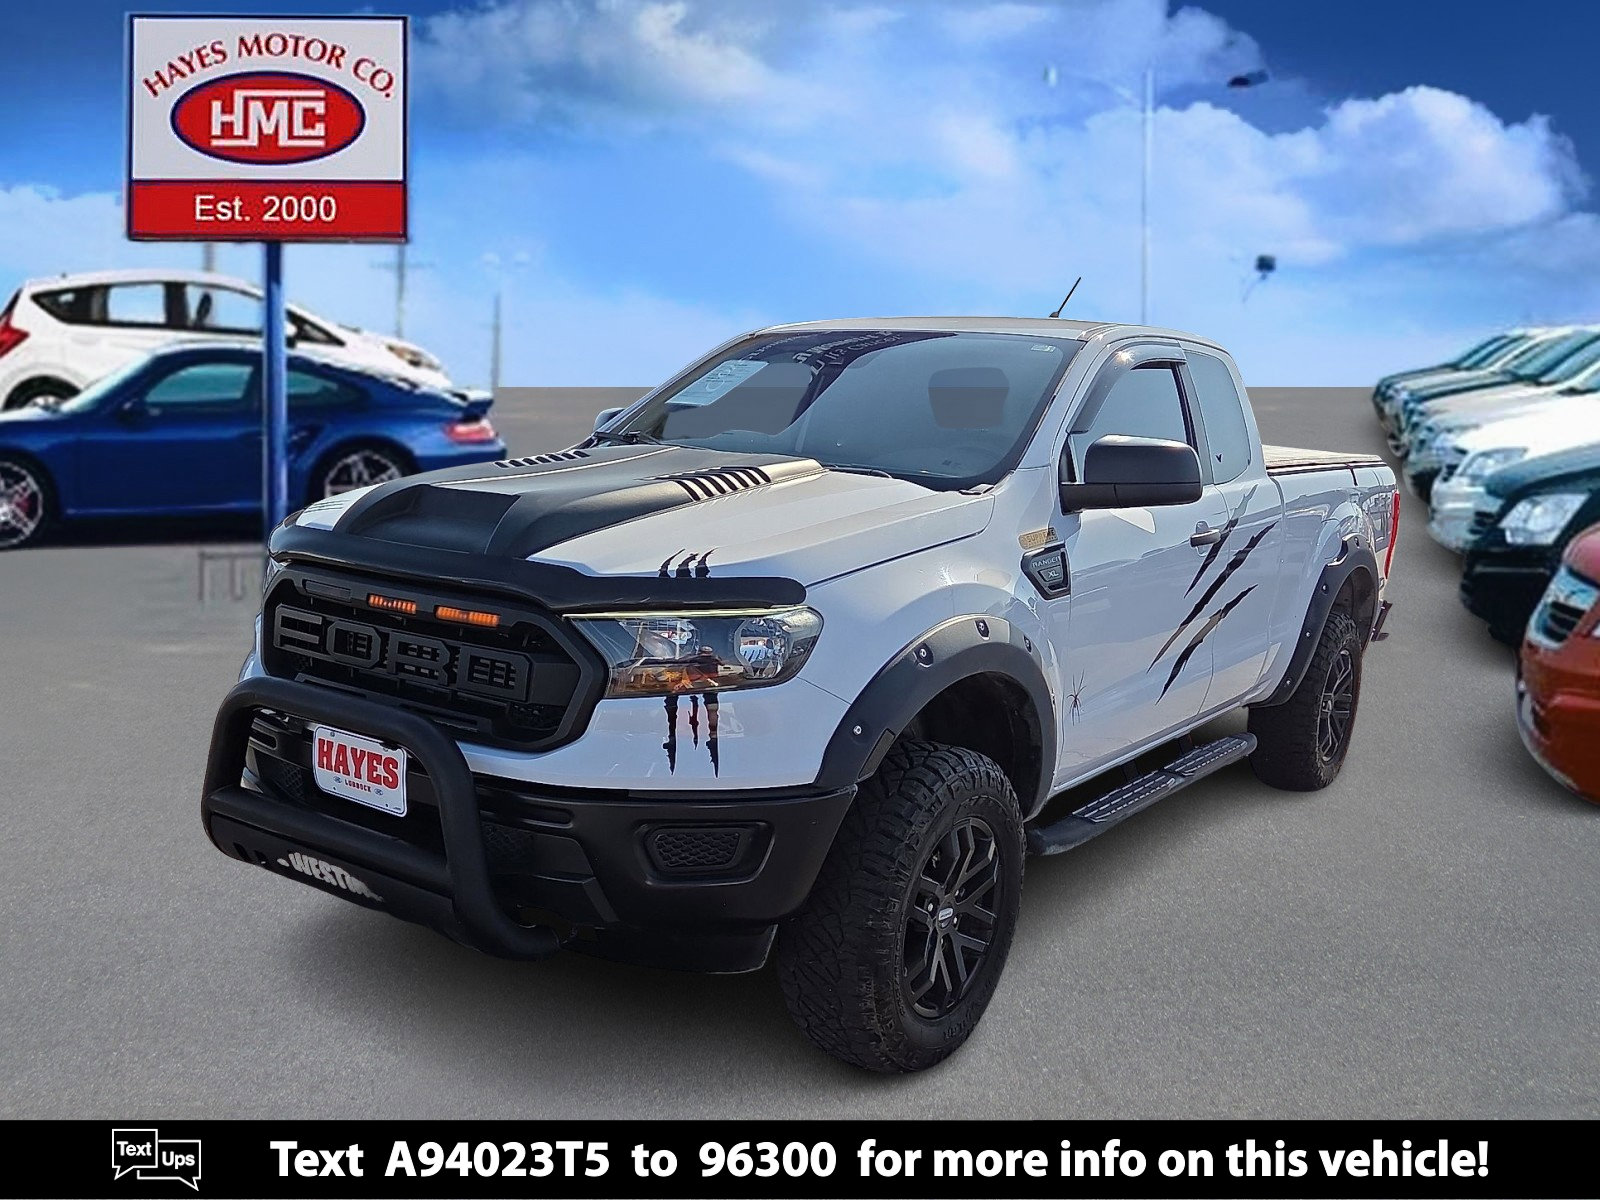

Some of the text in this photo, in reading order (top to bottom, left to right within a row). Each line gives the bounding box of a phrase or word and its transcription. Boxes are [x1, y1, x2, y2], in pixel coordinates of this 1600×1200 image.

[142, 33, 394, 98] HAYES MOTOR CO.
[210, 89, 326, 147] HMC
[195, 194, 337, 222] Est. 2000
[1026, 529, 1056, 543] SUPREE
[1048, 570, 1059, 578] XL
[273, 603, 530, 702] FORD
[317, 737, 399, 790] HAYES
